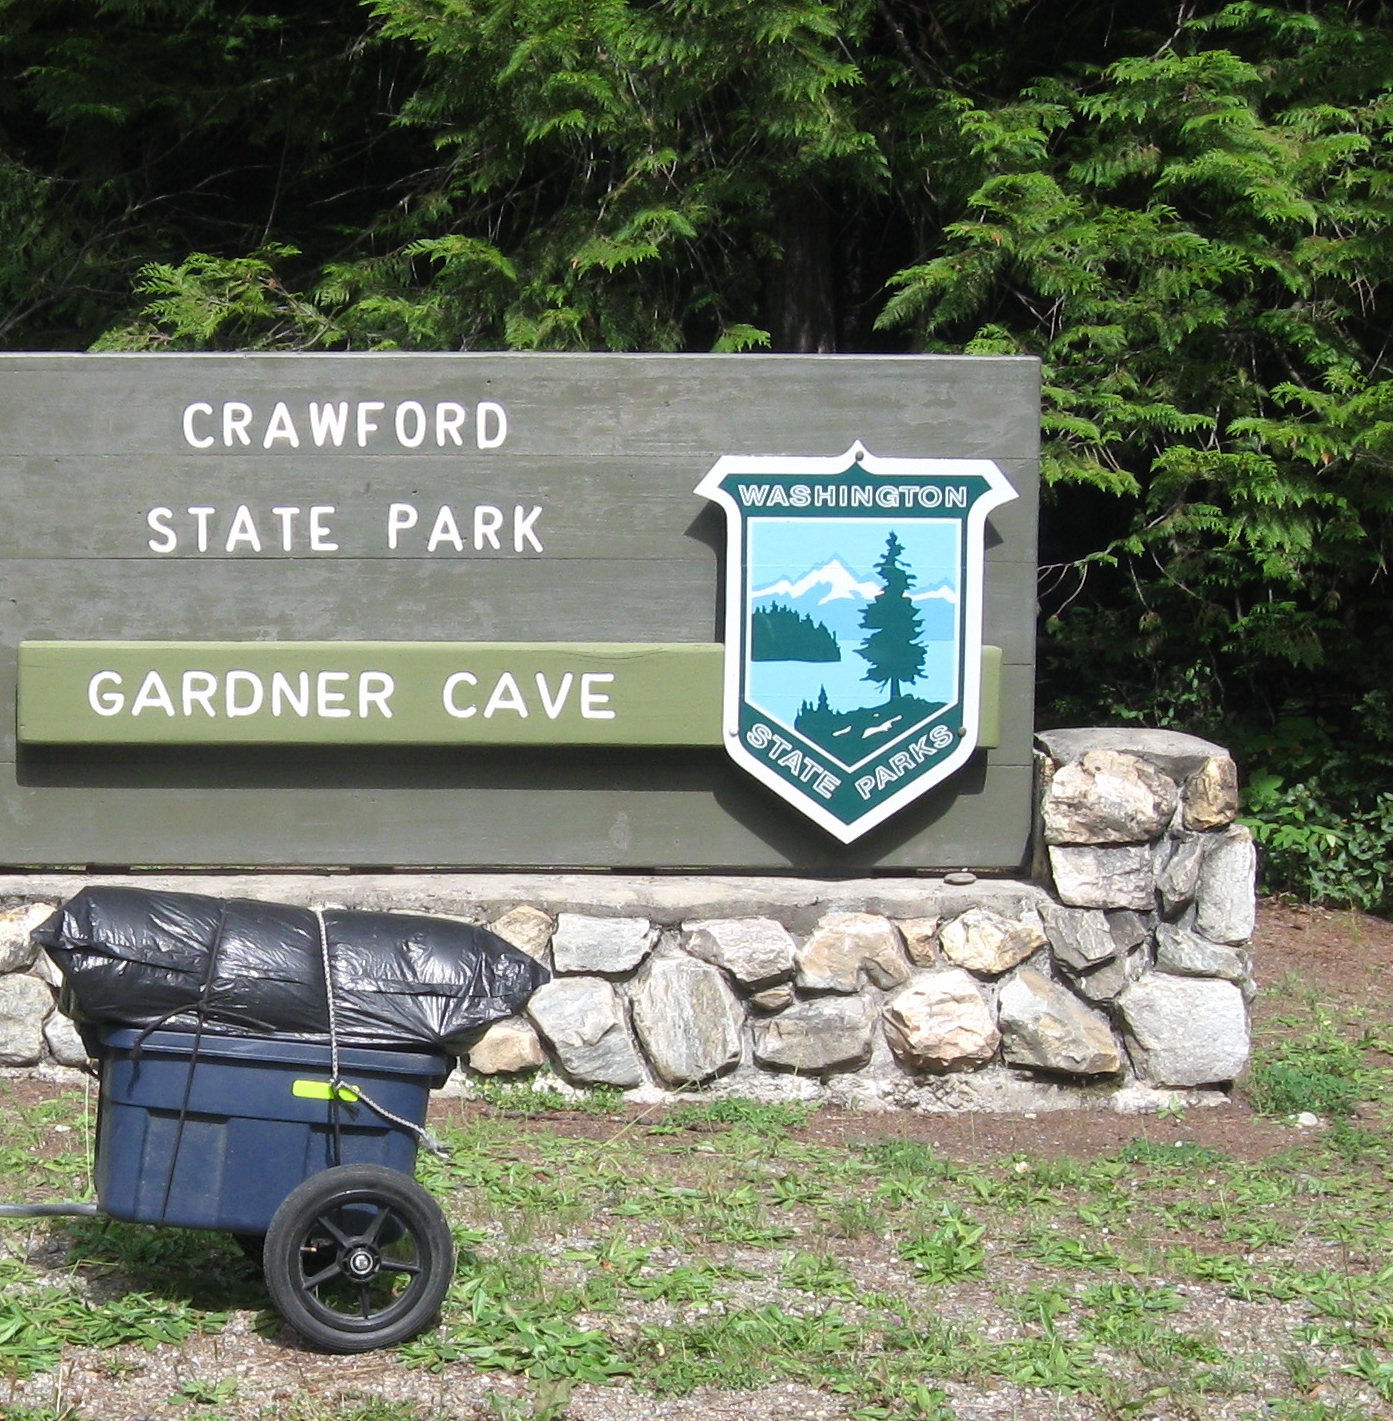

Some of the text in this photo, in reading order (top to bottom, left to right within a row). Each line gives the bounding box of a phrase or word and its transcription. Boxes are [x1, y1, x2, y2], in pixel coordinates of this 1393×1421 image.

[182, 400, 509, 450] CRAWFORD
[738, 484, 968, 509] WASHINGTON
[146, 502, 545, 554] STATE PARK
[87, 669, 617, 721] GARDNER CAVE
[746, 722, 955, 801] STATE PARKS
